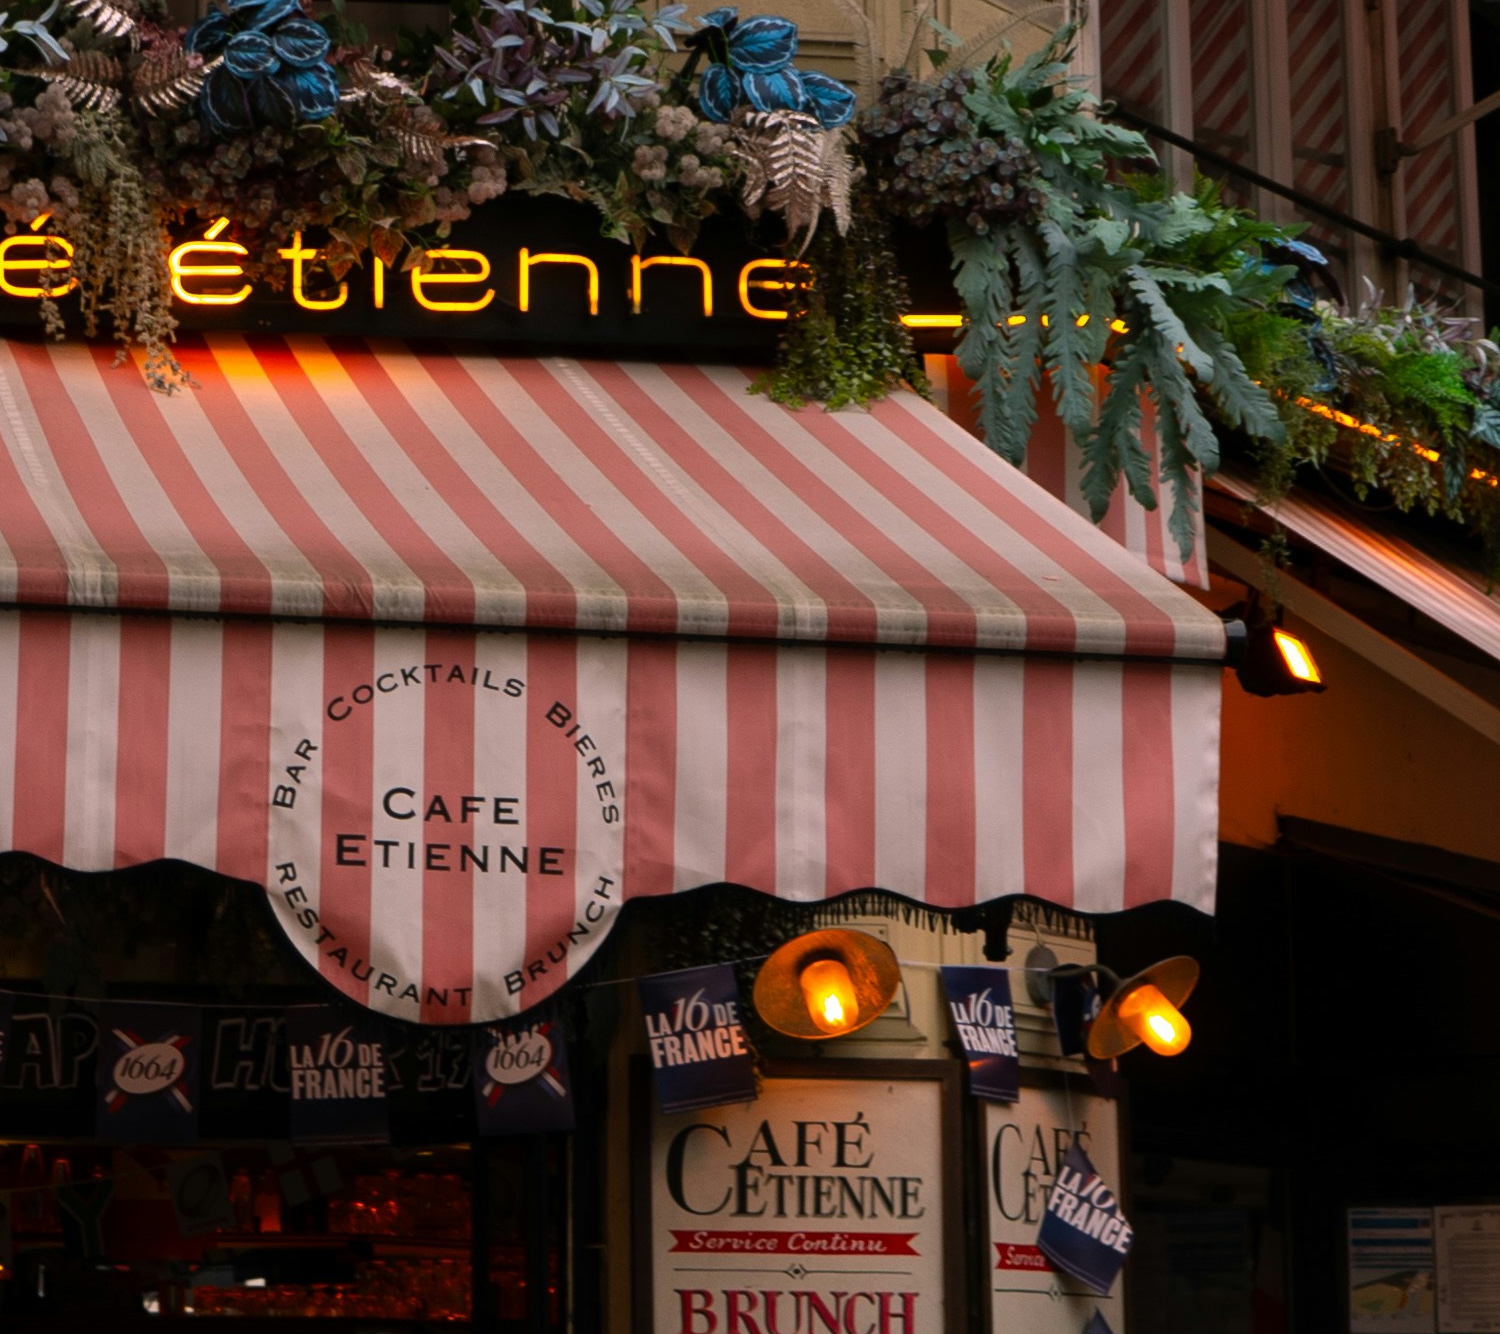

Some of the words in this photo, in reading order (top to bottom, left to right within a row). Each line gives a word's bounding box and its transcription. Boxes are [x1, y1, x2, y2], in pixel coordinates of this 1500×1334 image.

[272, 738, 318, 809] BAR
[326, 664, 526, 722] COCKTAILS
[545, 701, 620, 825] BIERES
[382, 787, 520, 825] CAFE
[335, 833, 565, 876] ETIENNE
[275, 861, 472, 1007] RESTAURANT
[503, 875, 614, 996] BRUNCH
[645, 1012, 672, 1038] LA
[672, 988, 710, 1033] 16
[714, 999, 738, 1027] DE
[950, 1001, 970, 1025] LA
[968, 988, 993, 1027] 16
[995, 1005, 1013, 1027] DE
[290, 1044, 313, 1068] LA
[315, 1025, 356, 1069] 16
[358, 1043, 384, 1067] DE
[492, 1043, 548, 1069] 1664
[649, 1025, 748, 1068] FRANCE
[957, 1024, 1019, 1058] FRANCE
[119, 1055, 177, 1081] 1664
[291, 1067, 387, 1100] FRANCE
[666, 1112, 874, 1217] CAFÉ
[1057, 1165, 1081, 1195] LA
[729, 1164, 925, 1219] ETIENNE
[1048, 1185, 1133, 1255] FRANCE
[688, 1231, 778, 1252] Service
[787, 1231, 887, 1253] Continu
